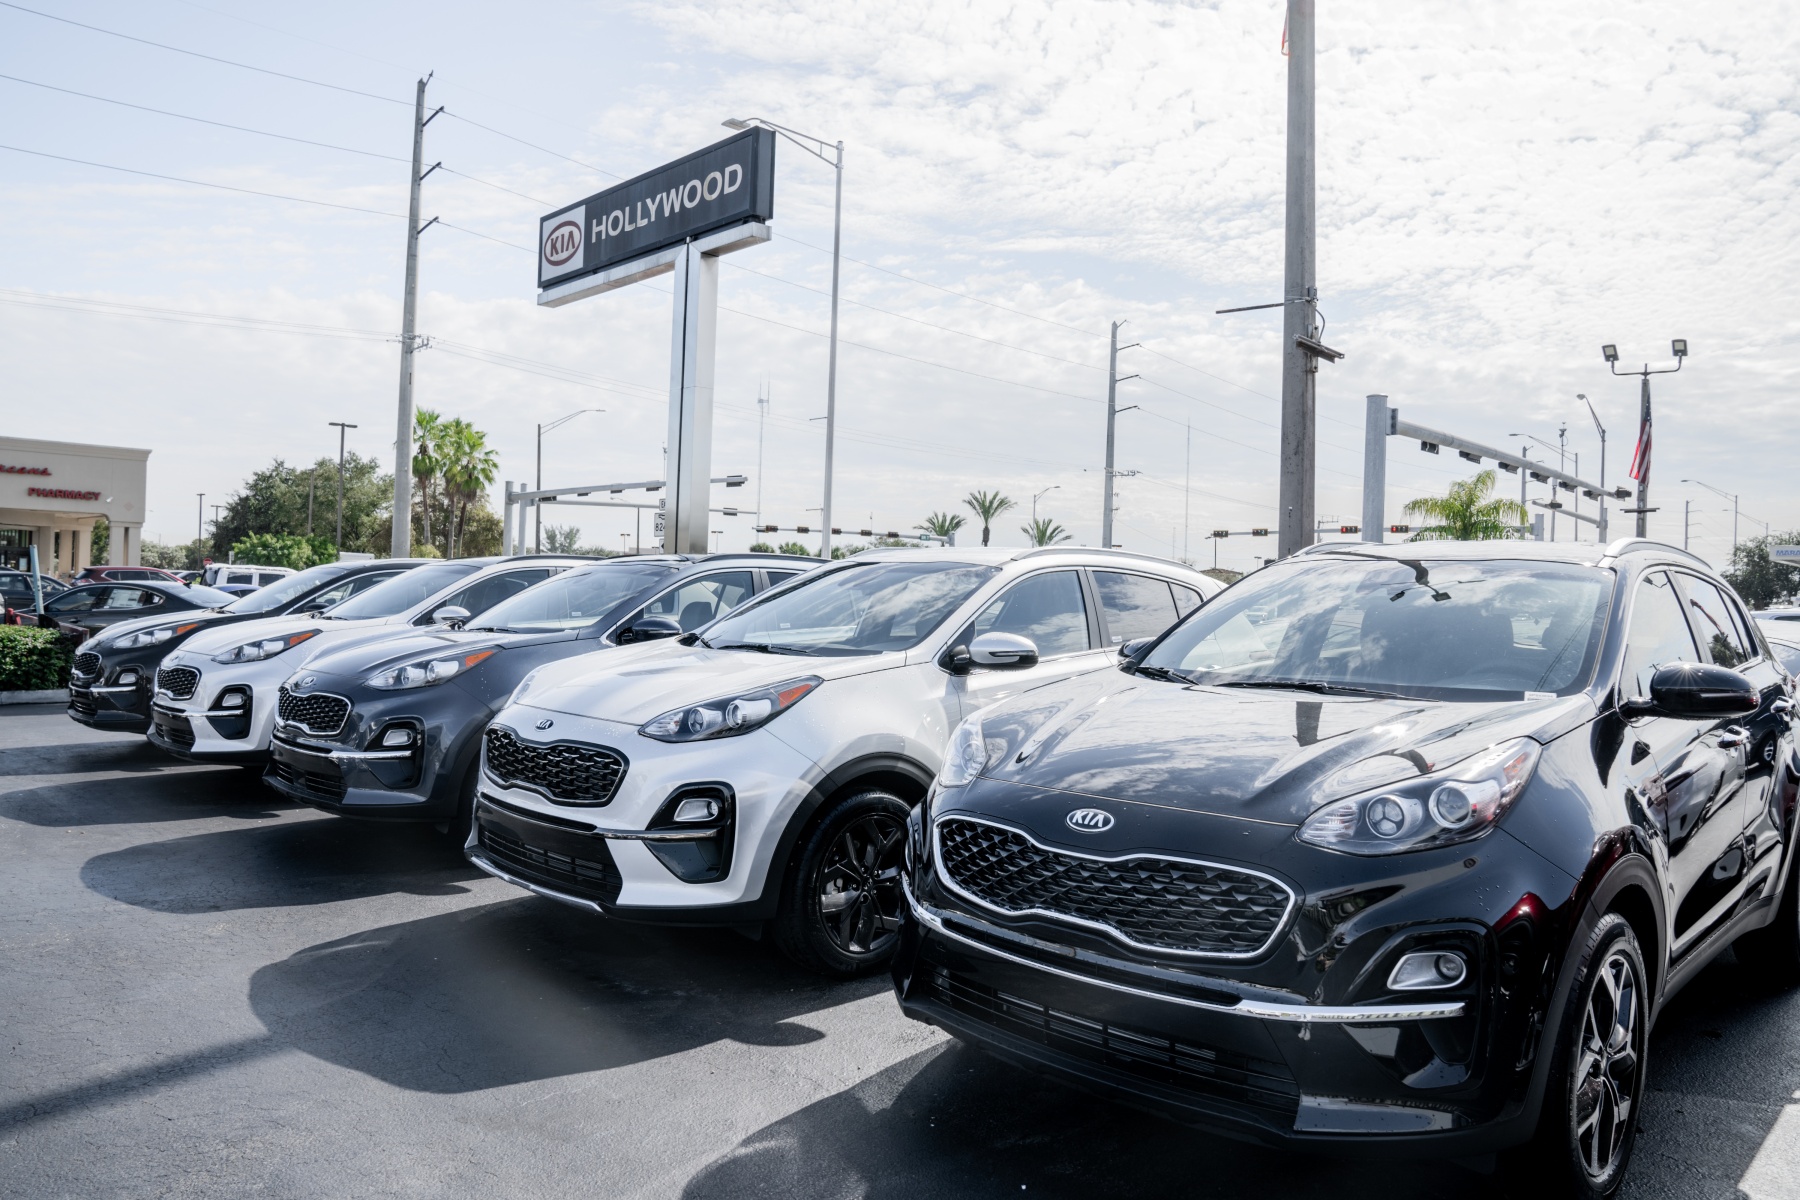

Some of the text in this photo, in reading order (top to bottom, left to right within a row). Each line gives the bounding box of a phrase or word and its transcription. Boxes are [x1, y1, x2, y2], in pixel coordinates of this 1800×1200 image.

[550, 163, 743, 258] KIA HOLLYWOOD
[28, 487, 101, 501] PHARMACY
[1072, 810, 1105, 828] KIA
